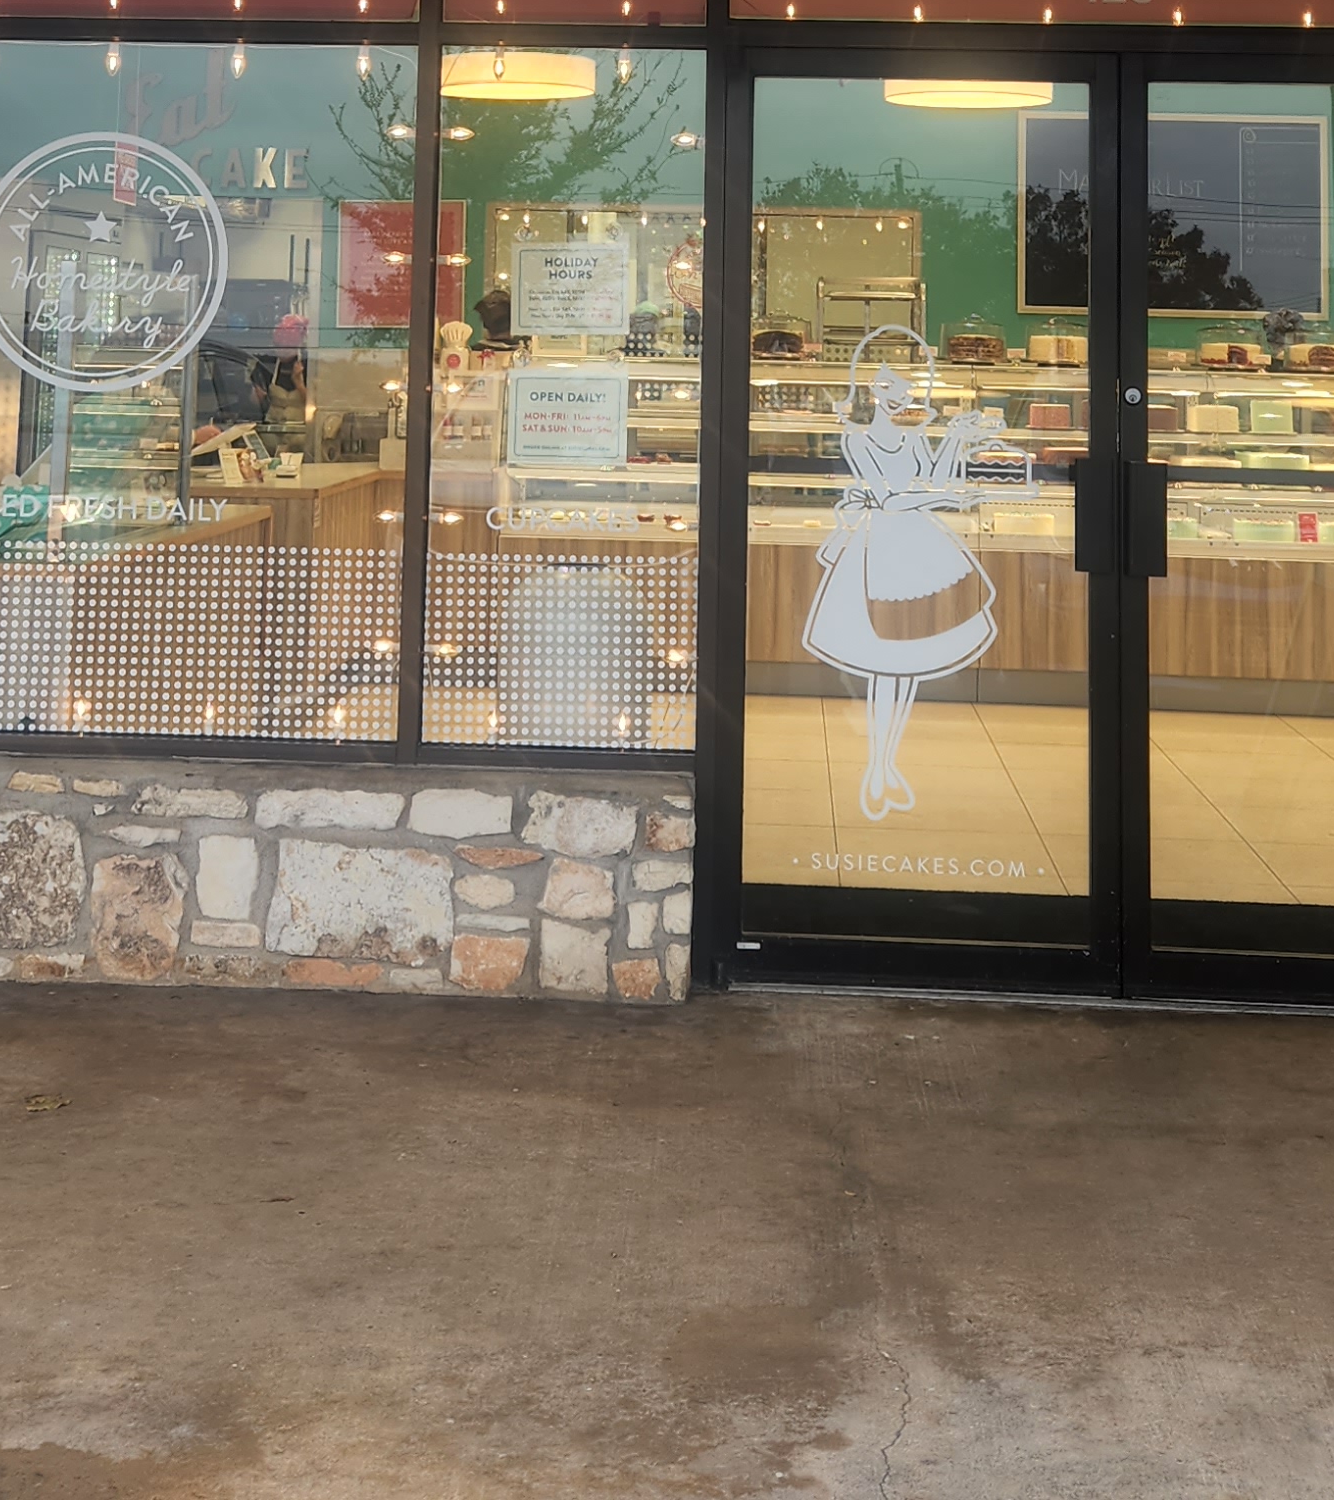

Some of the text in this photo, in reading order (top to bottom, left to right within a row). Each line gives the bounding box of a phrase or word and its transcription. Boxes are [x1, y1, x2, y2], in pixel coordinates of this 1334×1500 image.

[191, 146, 309, 189] CAKE
[9, 163, 194, 243] ALL-AMERICAN
[544, 257, 599, 268] HOLIDAY
[548, 269, 593, 280] HOURS
[11, 255, 191, 307] Homestyle
[529, 391, 564, 402] OPEN
[49, 494, 138, 520] FRESH
[145, 496, 227, 522] DAILY
[486, 506, 640, 533] CUPCAKES
[811, 852, 1026, 878] SUSIECAKES.COM
